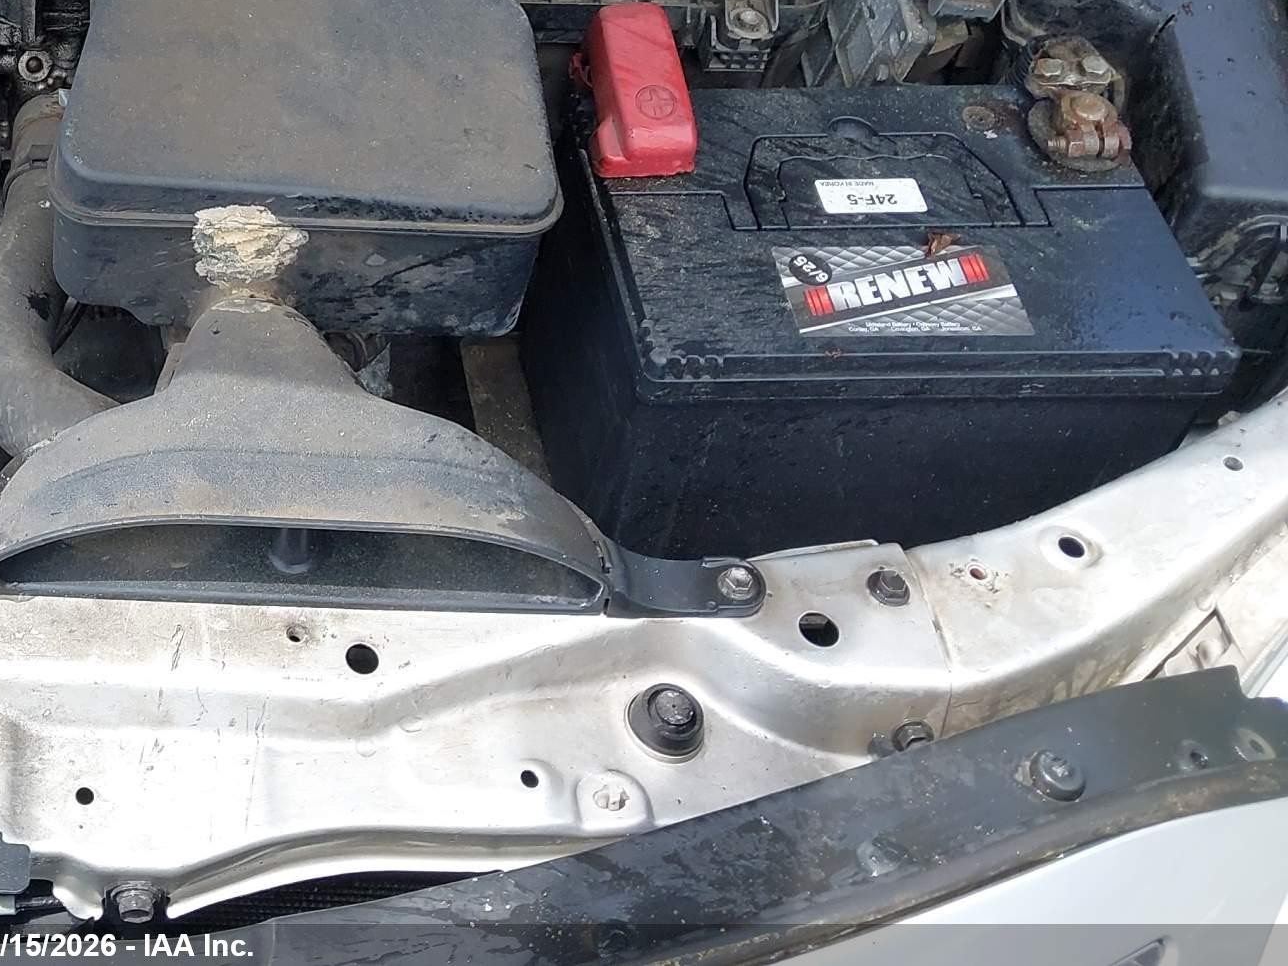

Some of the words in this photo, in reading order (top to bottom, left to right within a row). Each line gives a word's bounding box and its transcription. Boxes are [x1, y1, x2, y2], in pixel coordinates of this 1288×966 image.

[847, 194, 898, 205] 24F-5
[793, 255, 829, 284] 6/25
[826, 257, 968, 313] RENEW
